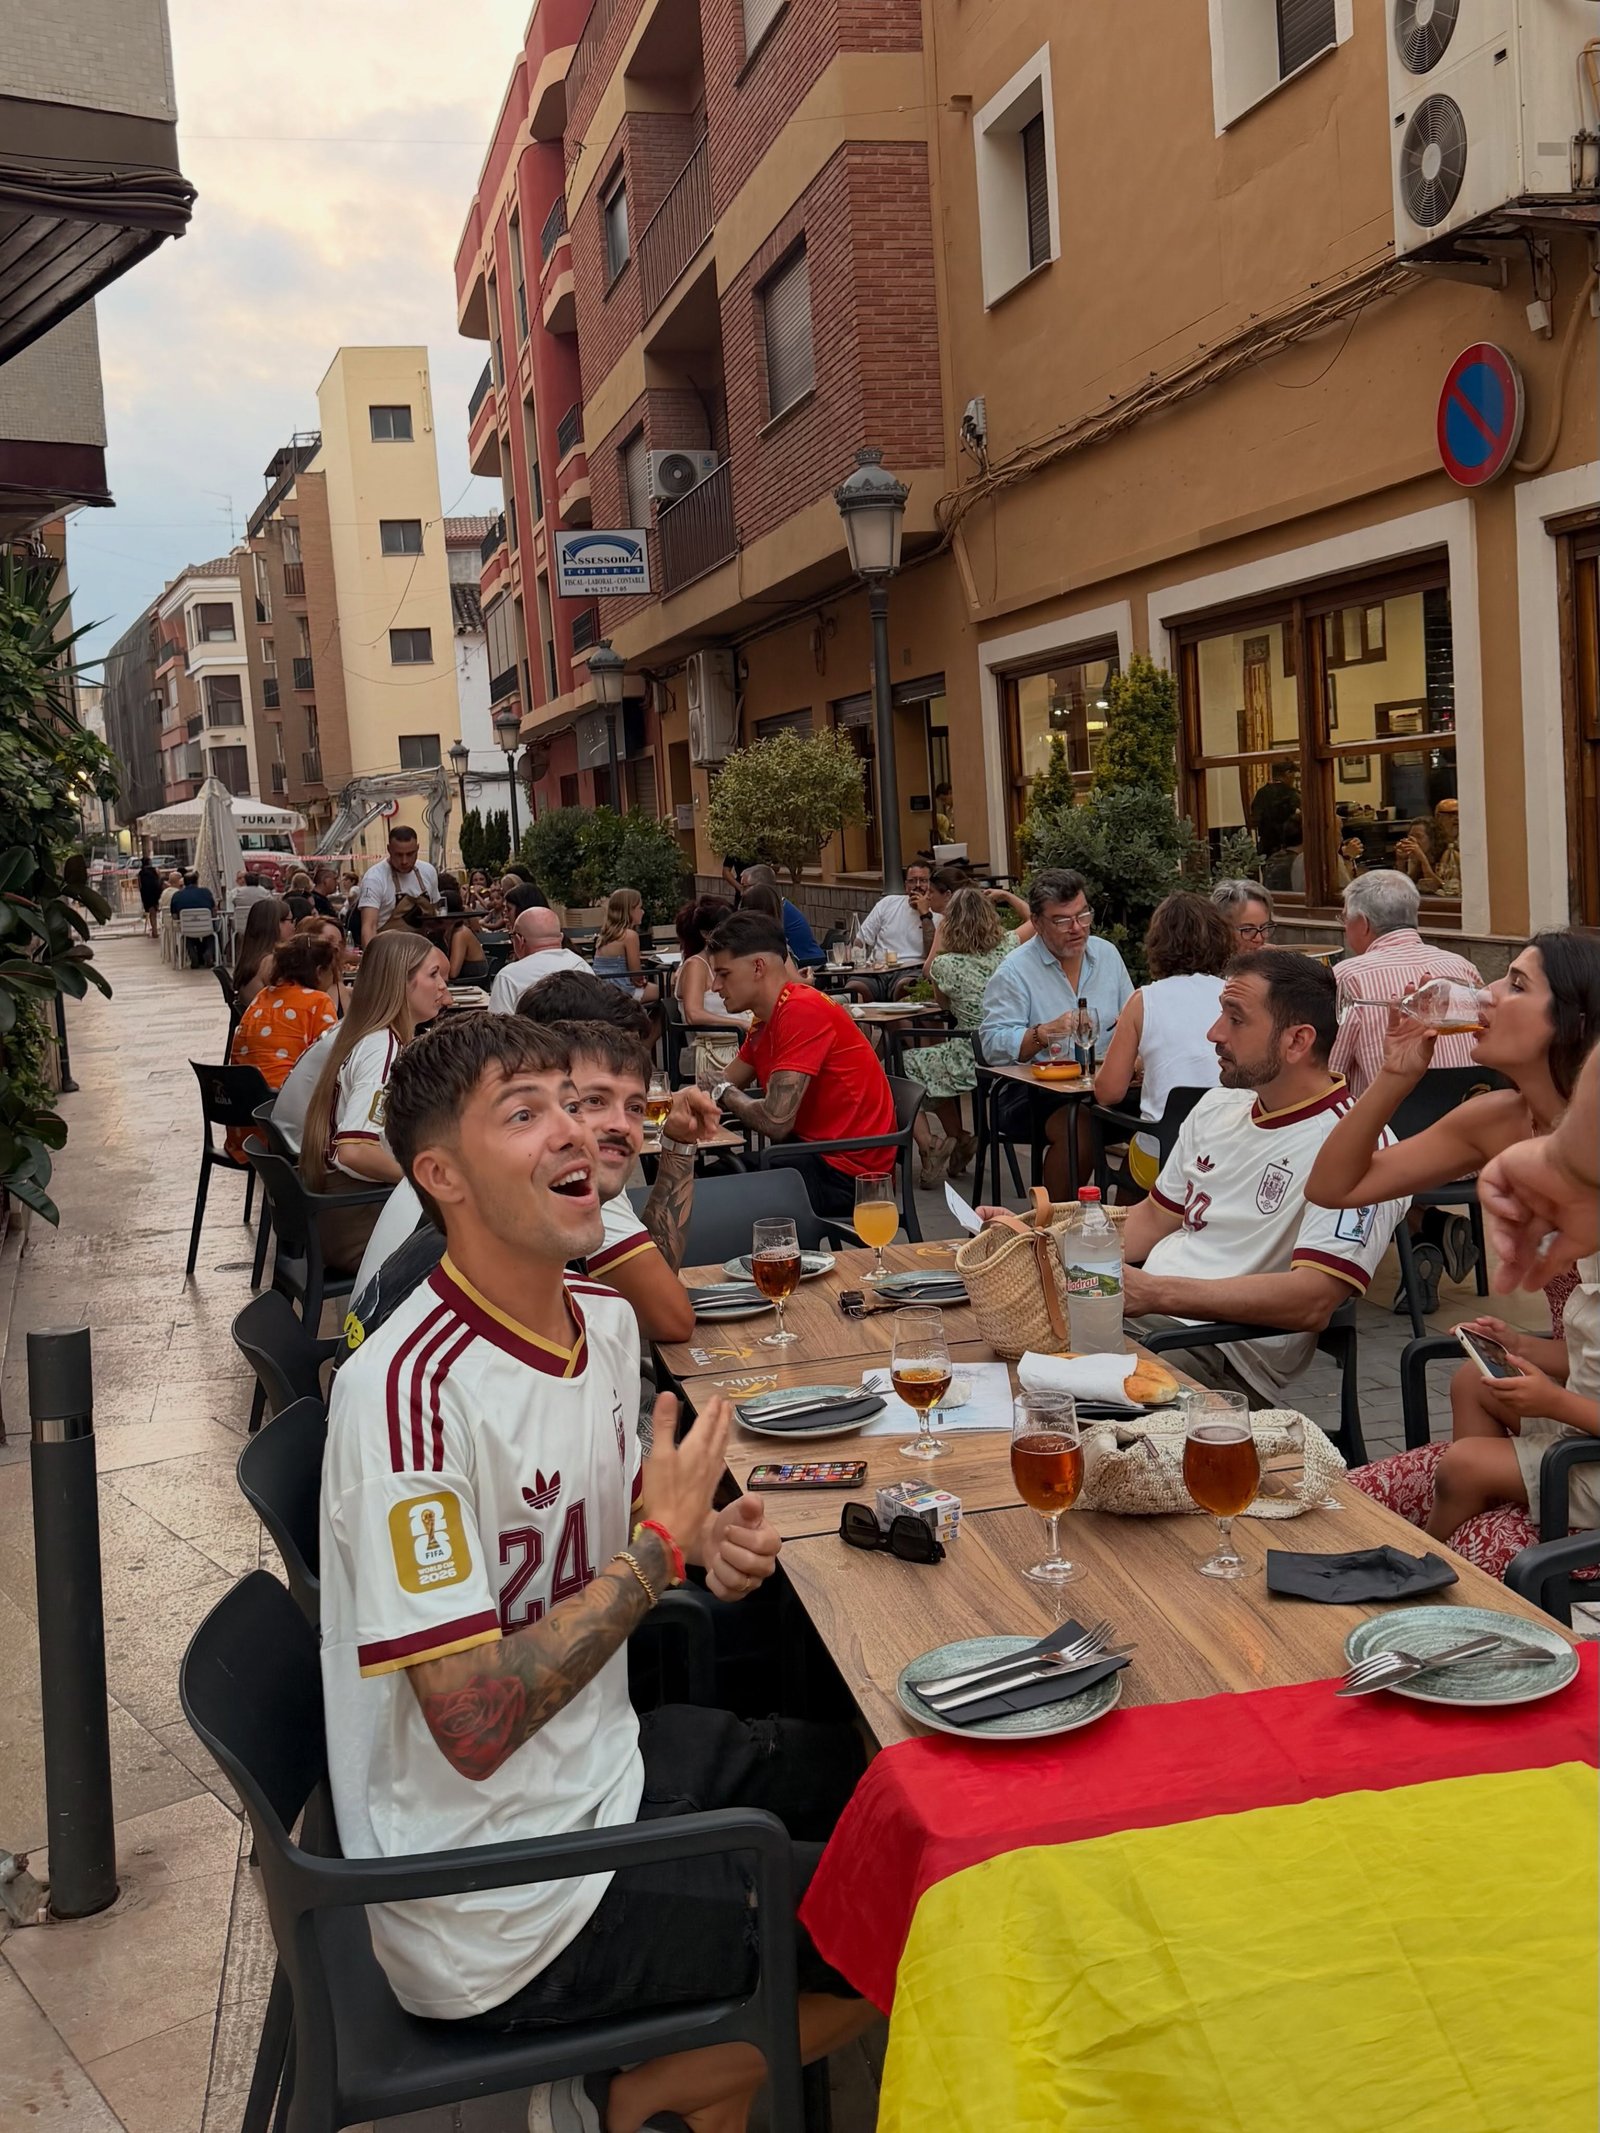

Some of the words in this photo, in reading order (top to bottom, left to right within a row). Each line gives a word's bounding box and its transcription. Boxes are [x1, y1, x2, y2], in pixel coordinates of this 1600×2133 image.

[563, 547, 643, 565] ASSESSORIA
[241, 816, 276, 824] TURIA
[425, 1549, 445, 1560] FIFA
[417, 1564, 443, 1575] WORLD
[443, 1561, 455, 1570] CUP
[498, 1498, 597, 1637] 24
[419, 1568, 457, 1585] 2026
